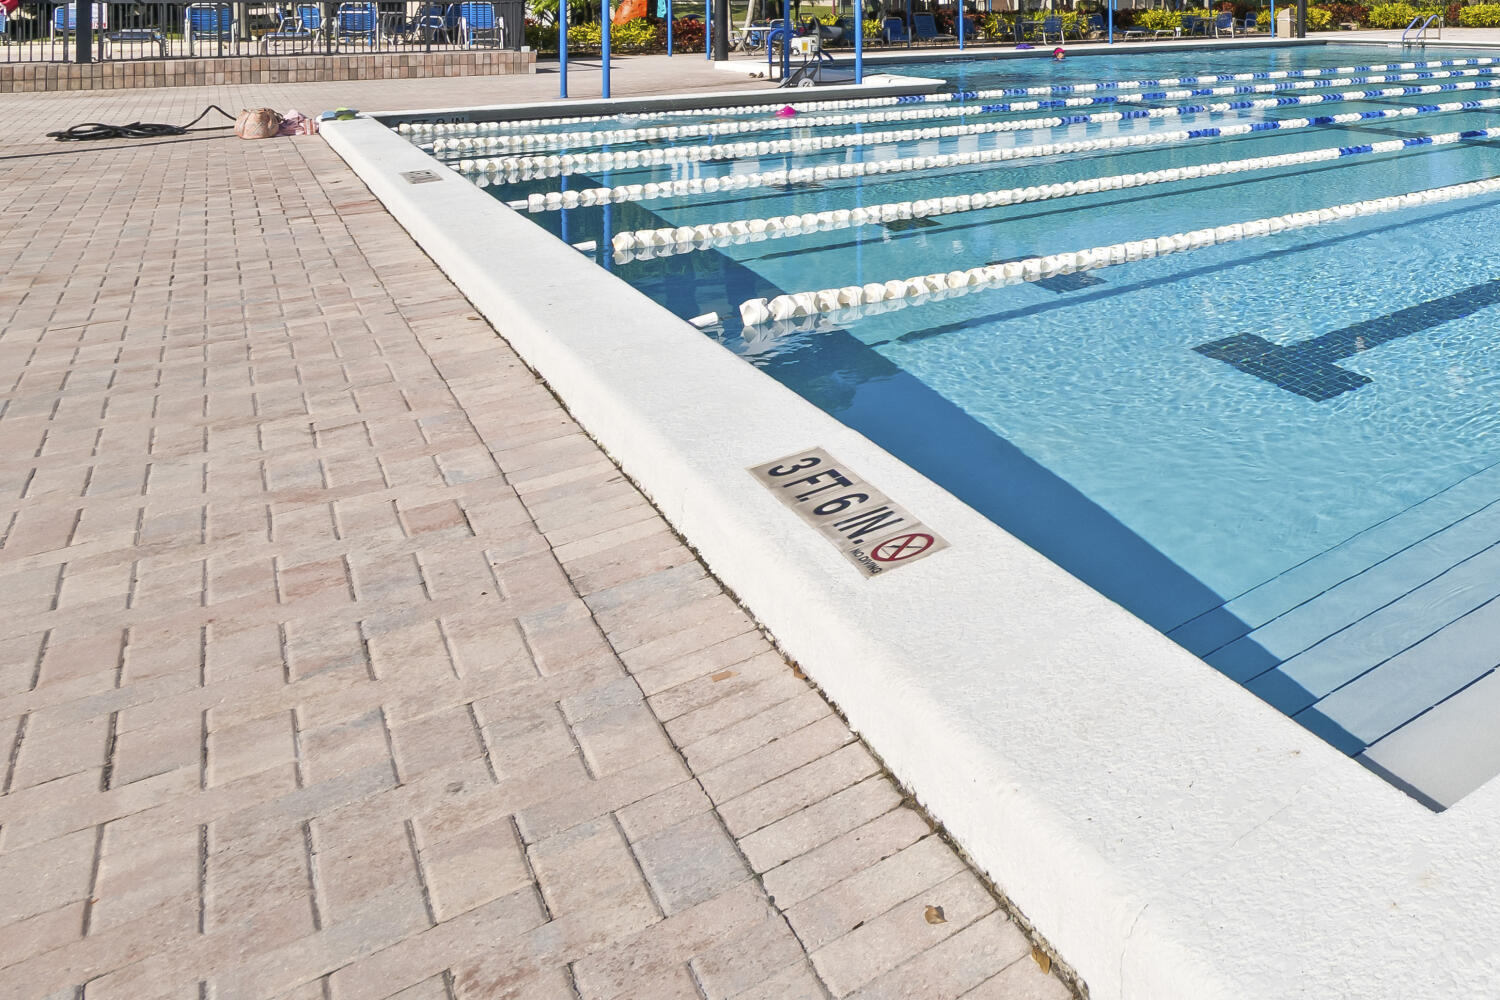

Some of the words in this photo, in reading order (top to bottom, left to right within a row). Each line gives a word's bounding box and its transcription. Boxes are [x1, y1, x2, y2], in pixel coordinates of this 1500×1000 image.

[768, 457, 821, 476] 3
[783, 468, 853, 502] FT.
[813, 493, 869, 515] 6
[833, 506, 904, 545] IN.
[850, 548, 864, 558] NO
[859, 556, 883, 574] DIVING
